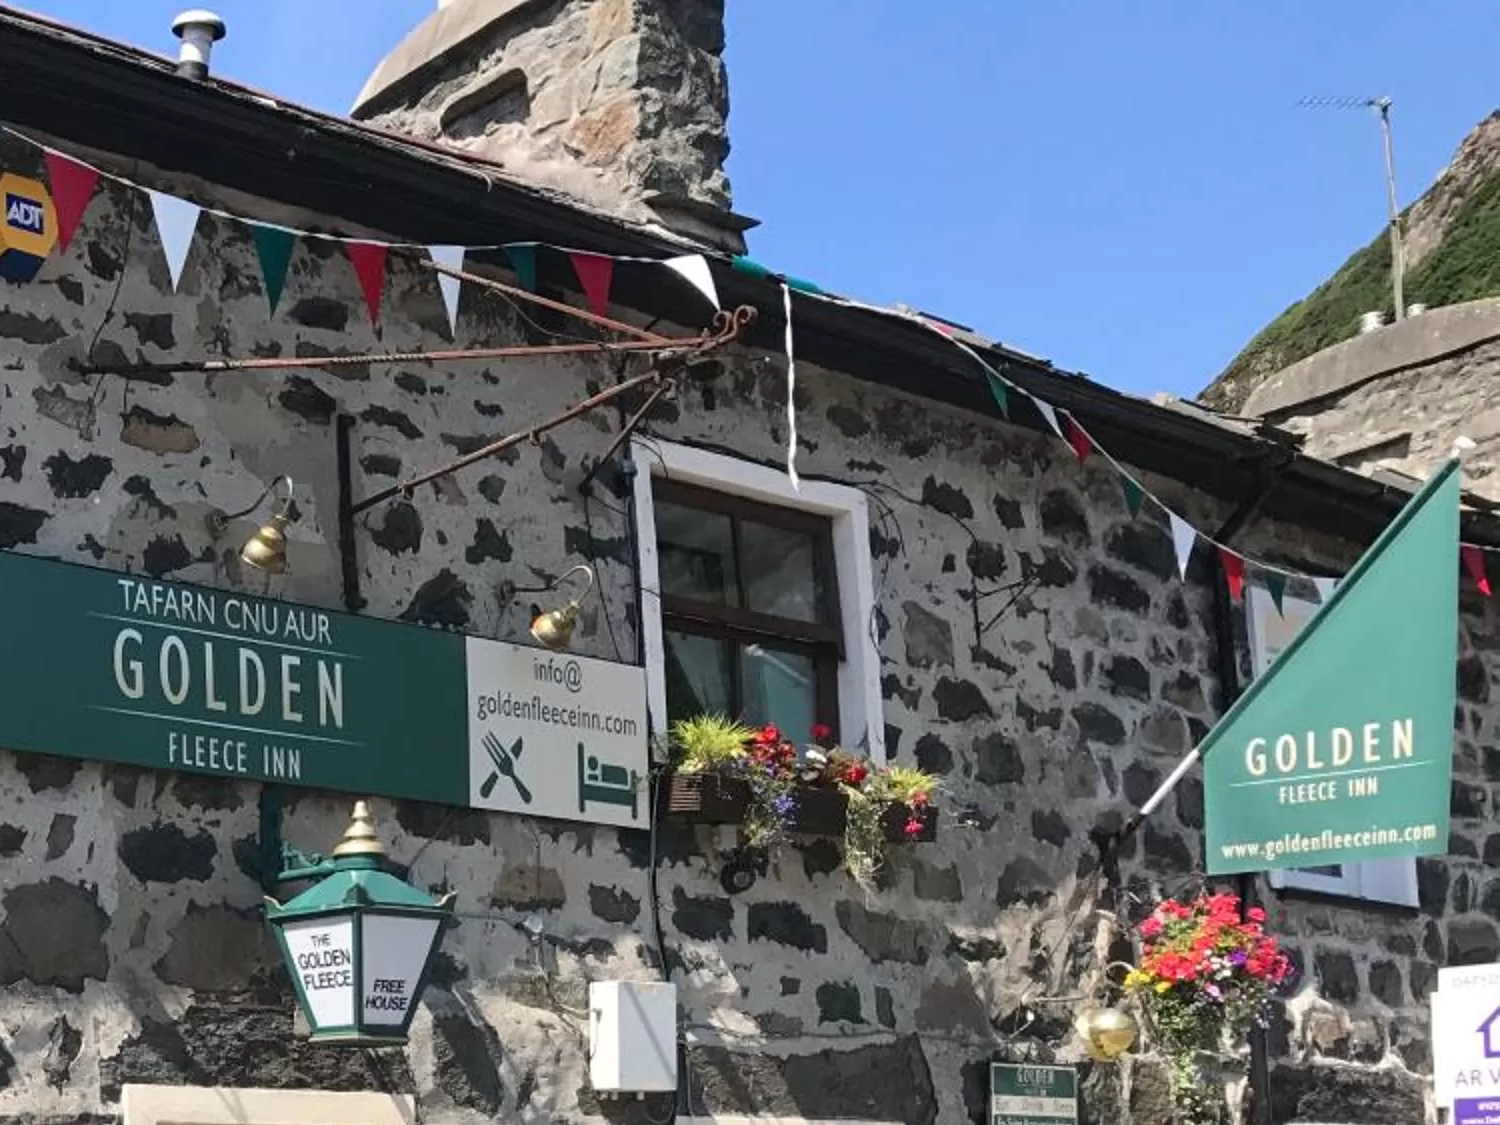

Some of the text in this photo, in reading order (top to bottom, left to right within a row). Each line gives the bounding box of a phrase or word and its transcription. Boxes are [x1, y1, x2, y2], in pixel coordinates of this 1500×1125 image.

[7, 201, 44, 229] ADT
[117, 579, 333, 645] TAFARN CNU AUR
[114, 627, 344, 730] GOLDEN
[533, 656, 583, 692] info@
[476, 693, 638, 738] goldenfleeceinn.com
[169, 731, 301, 779] FLEECE INN
[1245, 717, 1414, 776] GOLDEN
[1279, 776, 1379, 805] FLEECE INN
[1221, 822, 1438, 861] www.goldenfleeceinn.com
[311, 933, 331, 947] THE
[298, 948, 350, 970] GOLDEN
[303, 970, 353, 990] FLEECE
[373, 978, 405, 994] FREE
[365, 995, 408, 1012] HOUSE
[1455, 1069, 1483, 1089] AR
